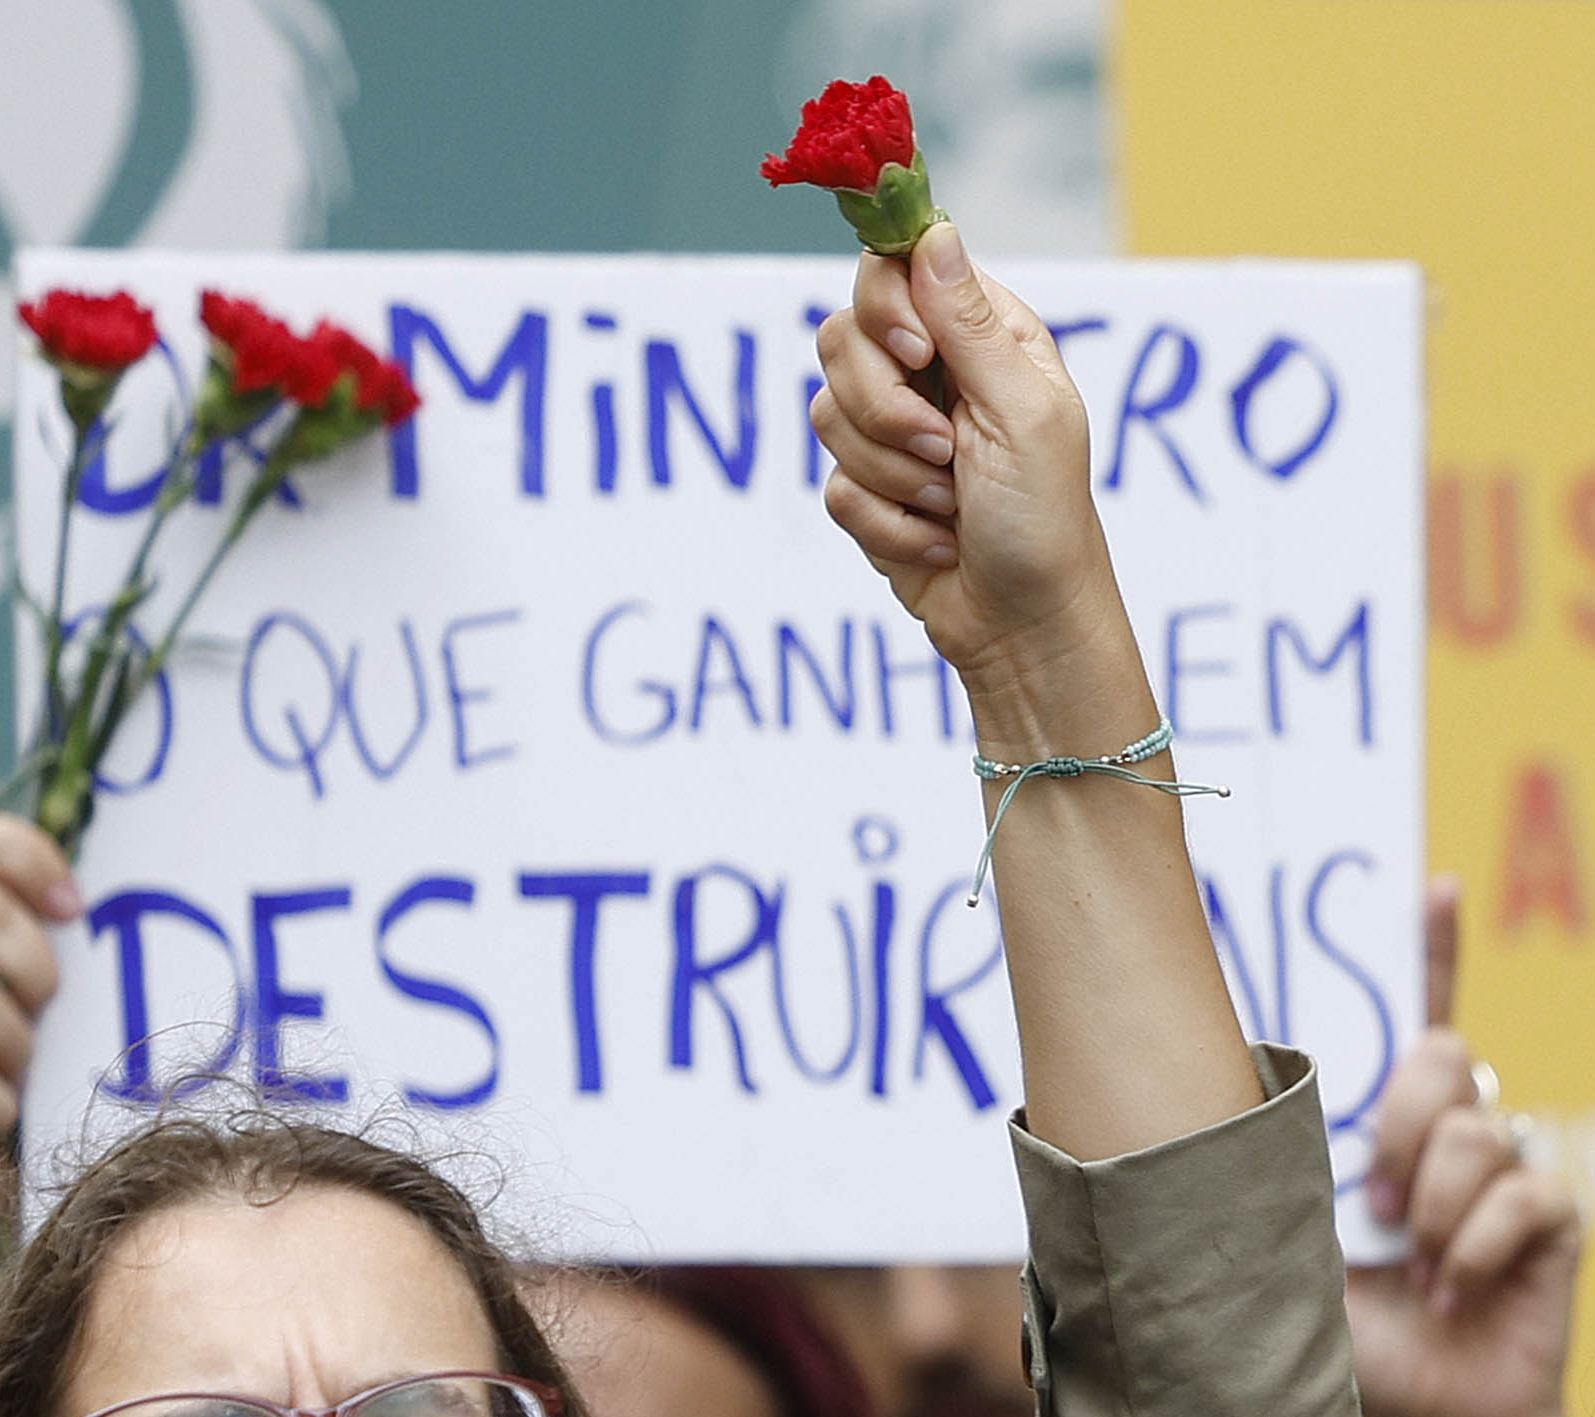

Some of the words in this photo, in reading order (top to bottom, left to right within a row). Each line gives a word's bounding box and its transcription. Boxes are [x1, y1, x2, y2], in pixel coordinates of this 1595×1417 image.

[1424, 470, 1521, 648] U
[241, 608, 523, 800] QUE
[581, 603, 972, 747] GANH
[1166, 597, 1374, 746] EM
[1503, 762, 1588, 937] A
[1203, 850, 1394, 1130] NS
